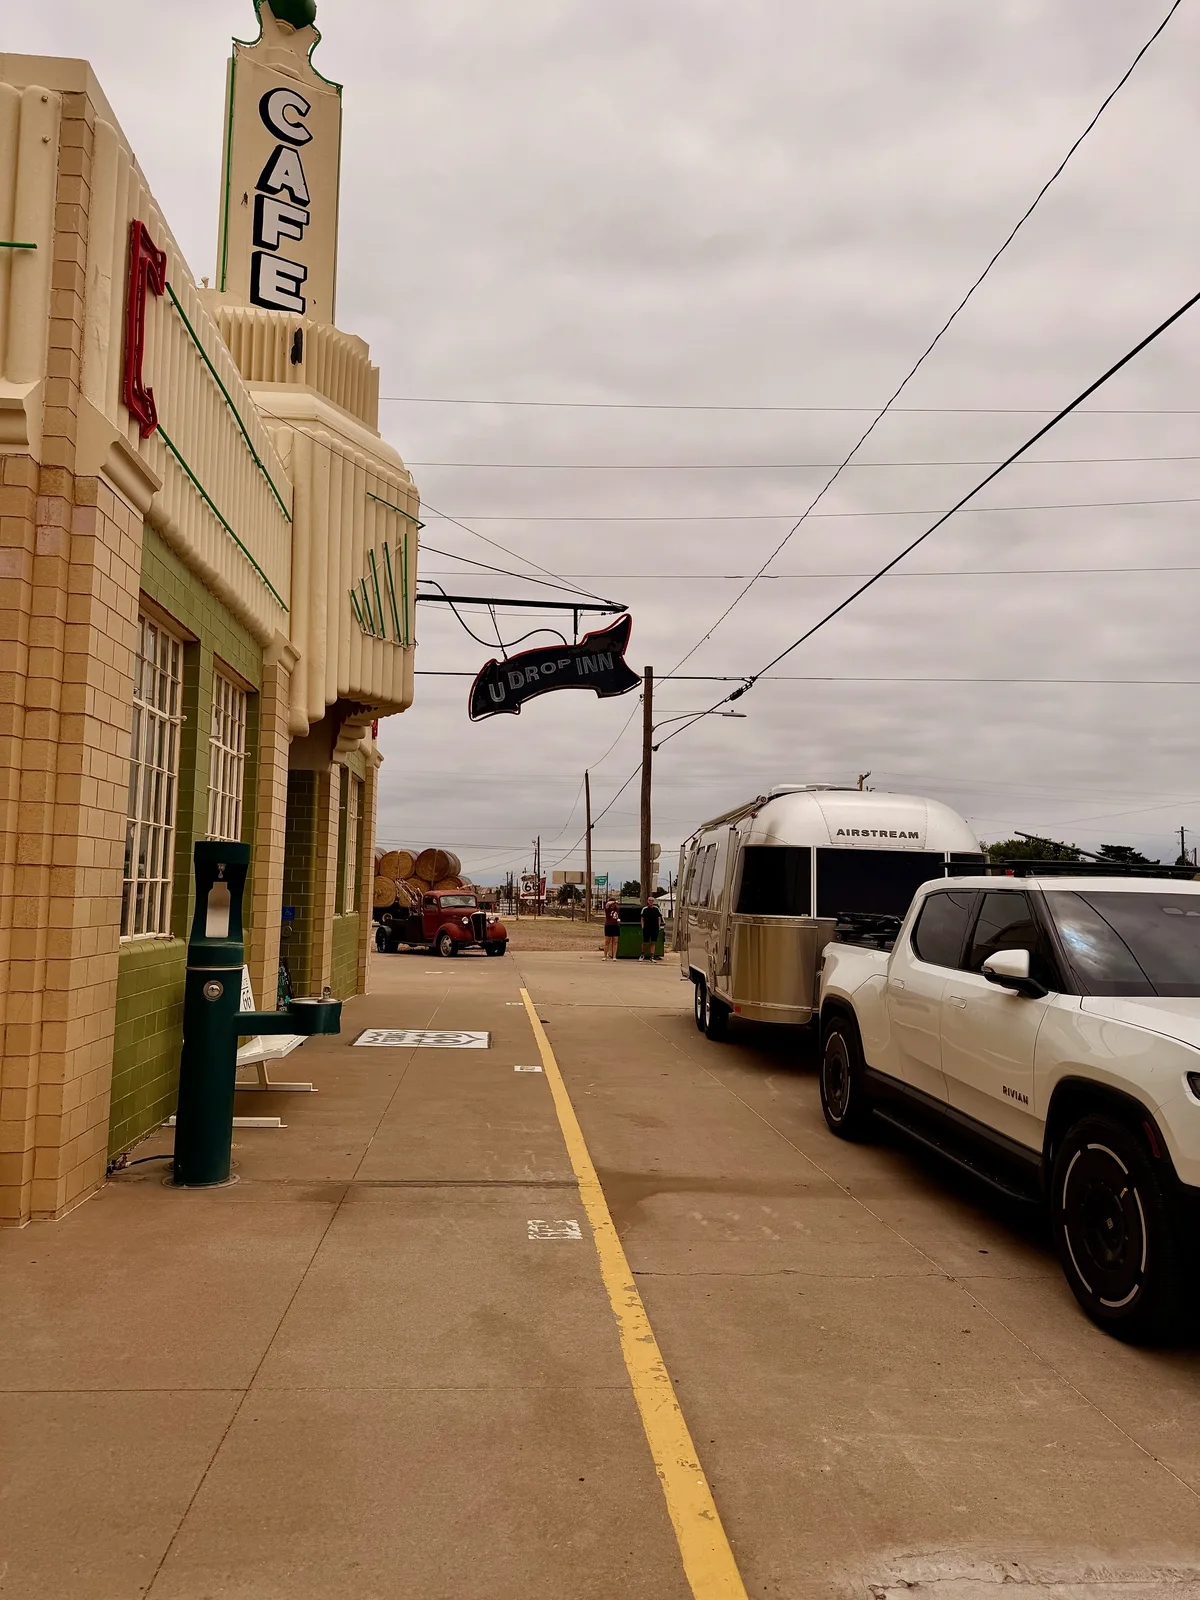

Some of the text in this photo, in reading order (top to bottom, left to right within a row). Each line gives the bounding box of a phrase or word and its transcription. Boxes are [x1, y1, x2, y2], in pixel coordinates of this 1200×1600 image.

[250, 87, 313, 315] CAFE
[488, 652, 614, 703] U DROP INN
[836, 829, 919, 839] AIRSTREAM
[1003, 1085, 1029, 1105] RIVIAN
